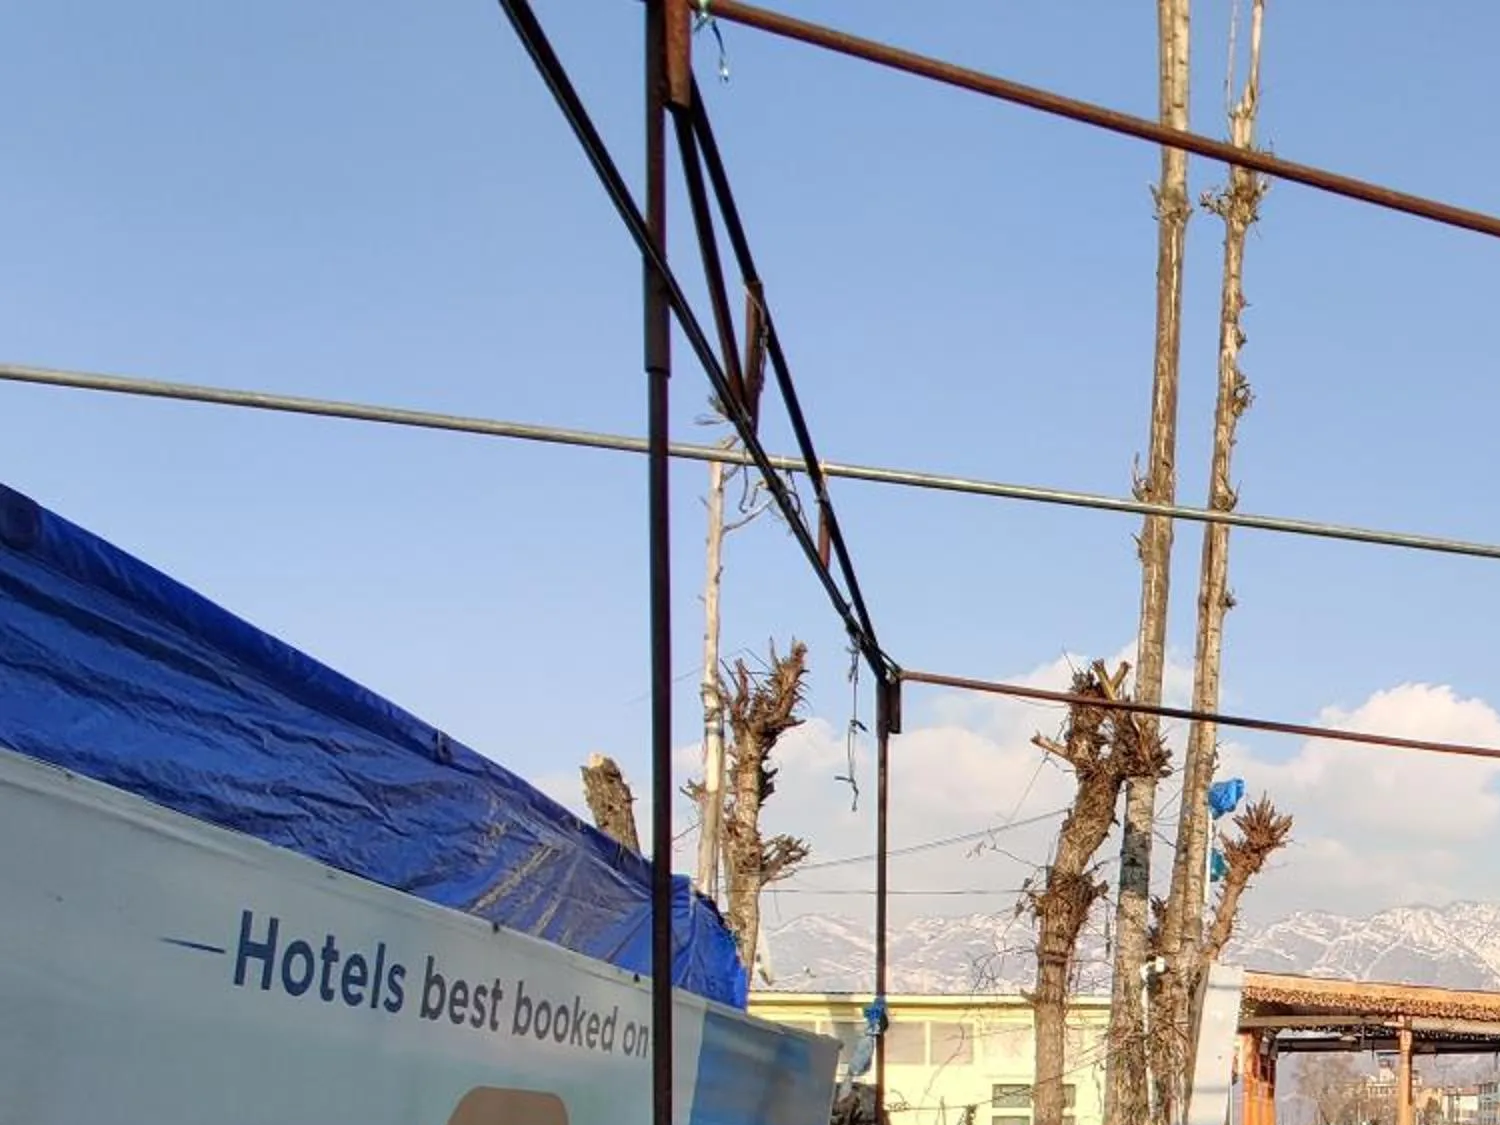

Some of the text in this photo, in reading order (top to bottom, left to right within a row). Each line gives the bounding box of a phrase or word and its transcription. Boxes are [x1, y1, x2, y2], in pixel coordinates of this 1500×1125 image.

[234, 910, 649, 1058] Hotels best booked on
